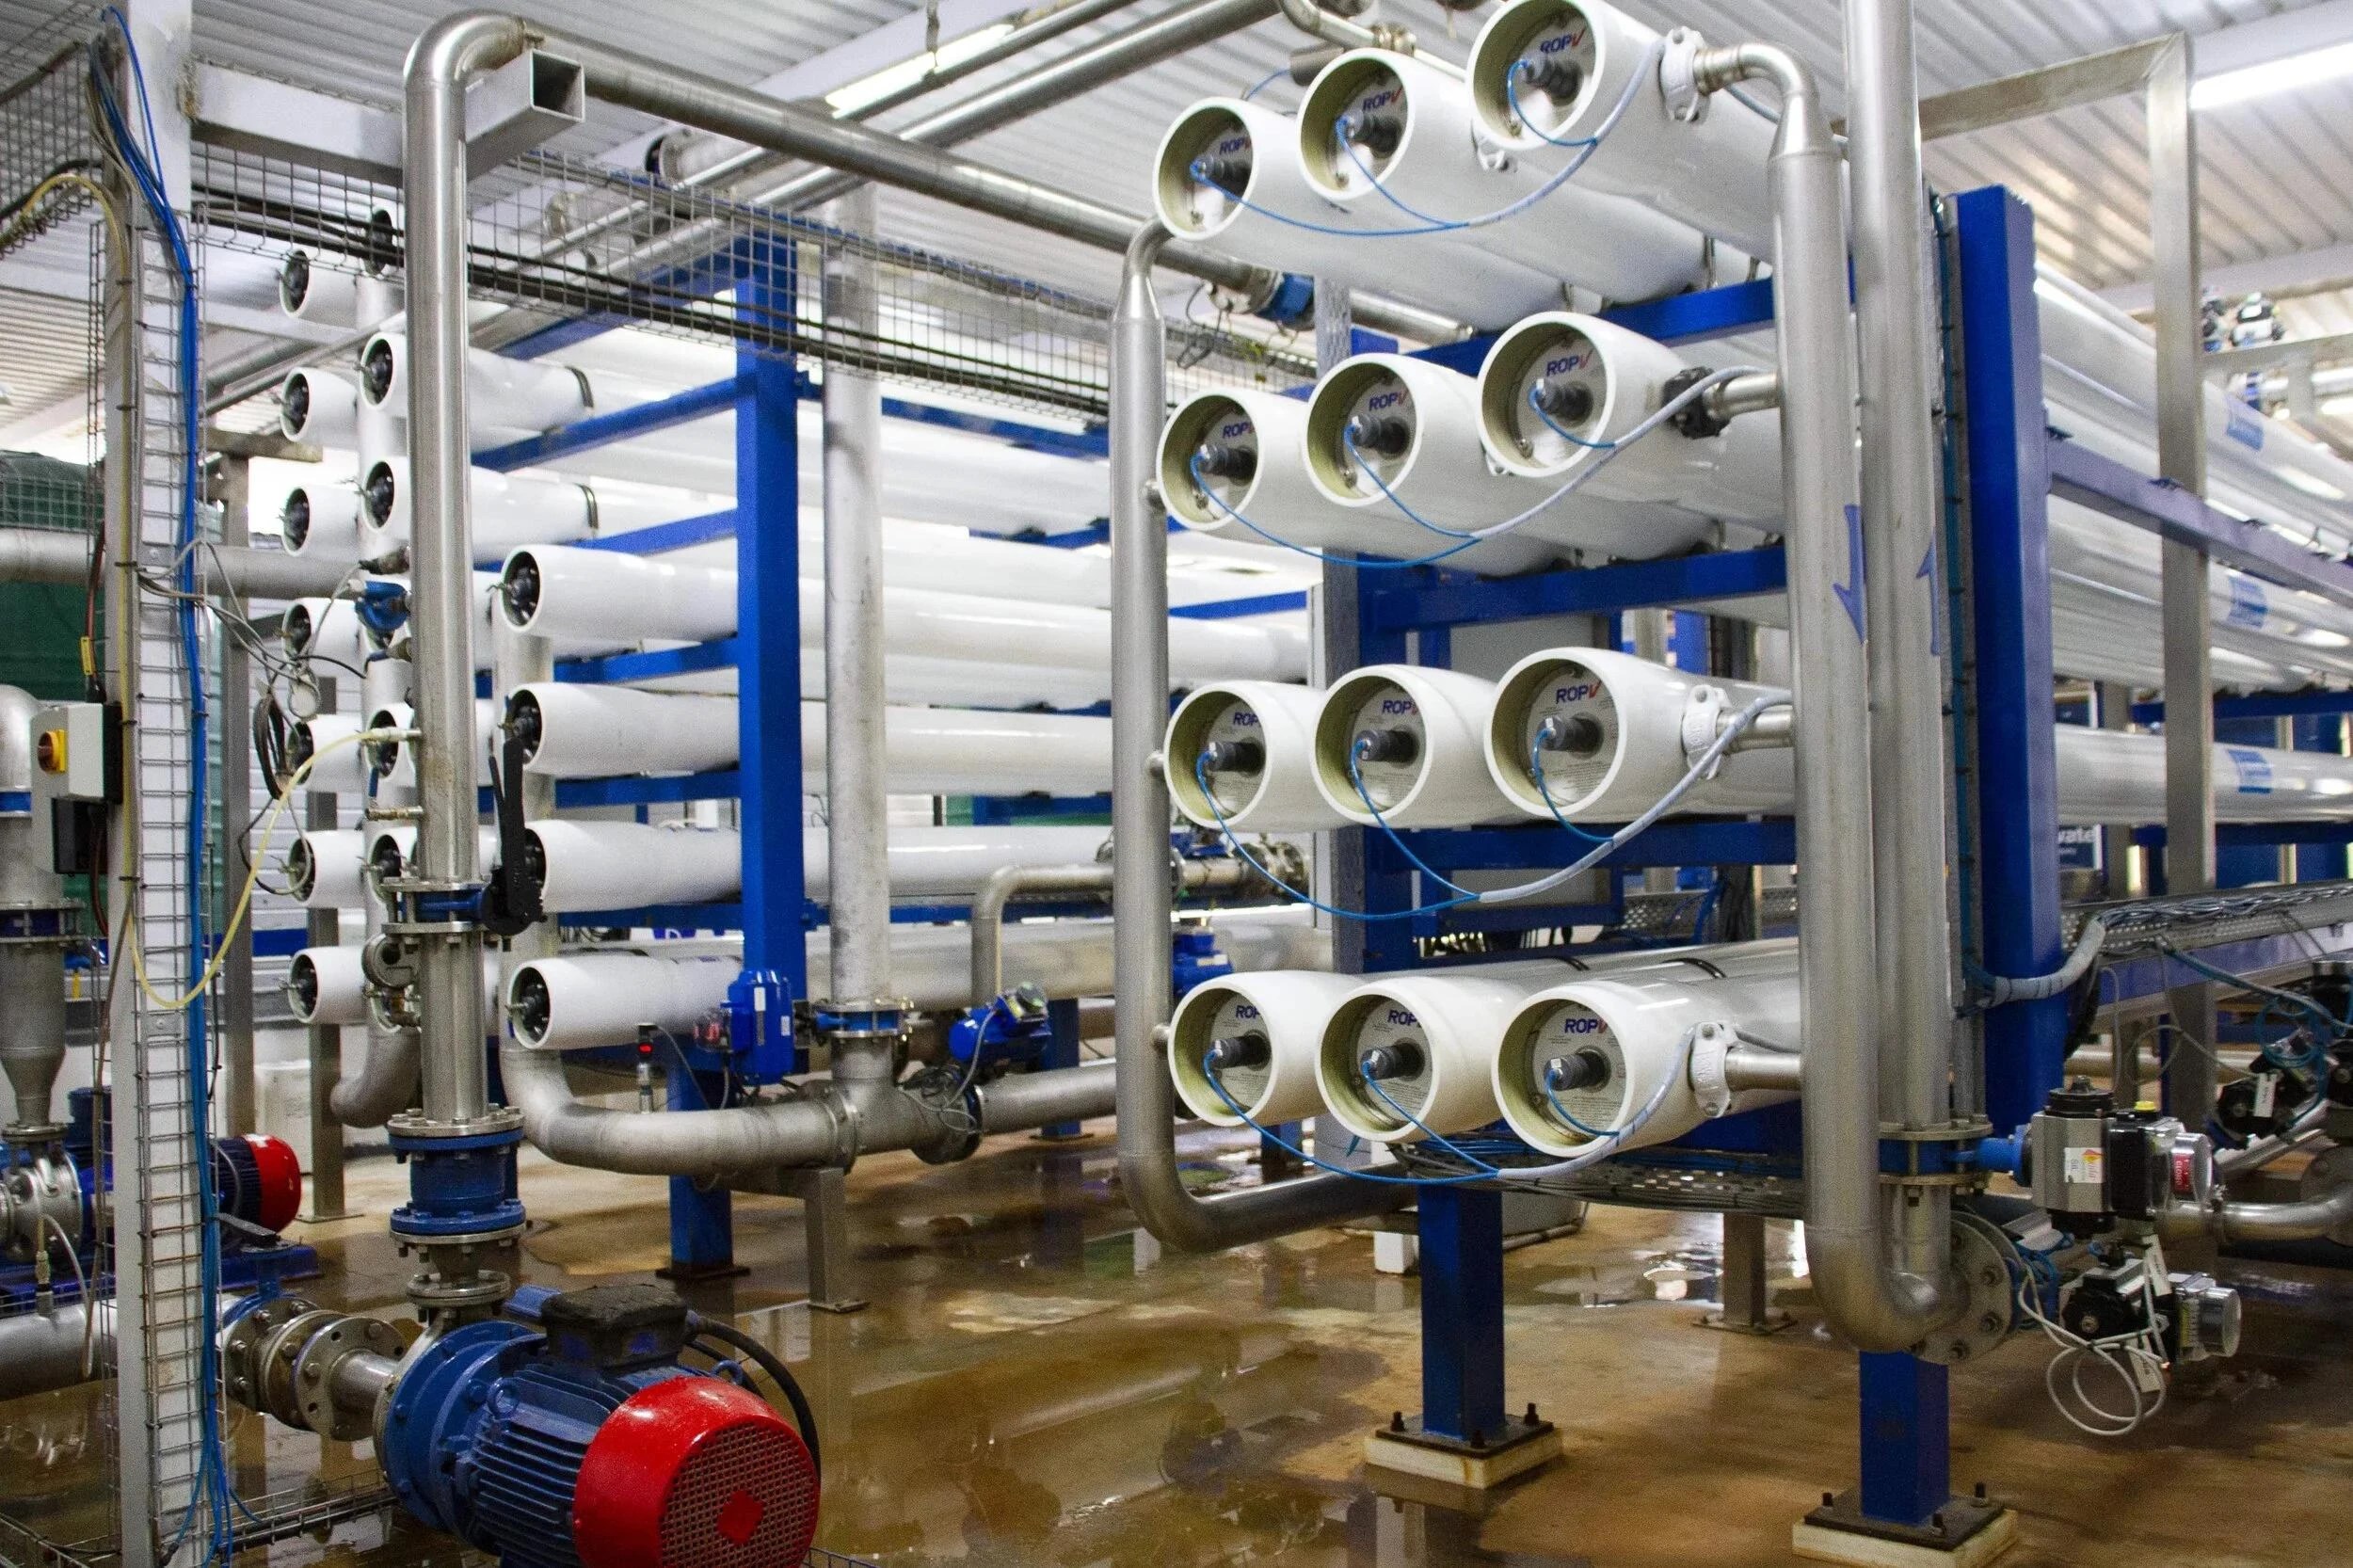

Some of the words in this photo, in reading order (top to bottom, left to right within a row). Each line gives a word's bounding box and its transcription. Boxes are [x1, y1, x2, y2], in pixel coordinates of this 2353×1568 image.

[1540, 26, 1585, 53] ROPV
[1363, 86, 1403, 111] ROPV
[1546, 348, 1593, 376] ROPV
[1369, 389, 1408, 411] ROPV
[1556, 680, 1602, 704] ROPV
[1233, 712, 1261, 727] ROP
[1387, 1009, 1422, 1028] ROP
